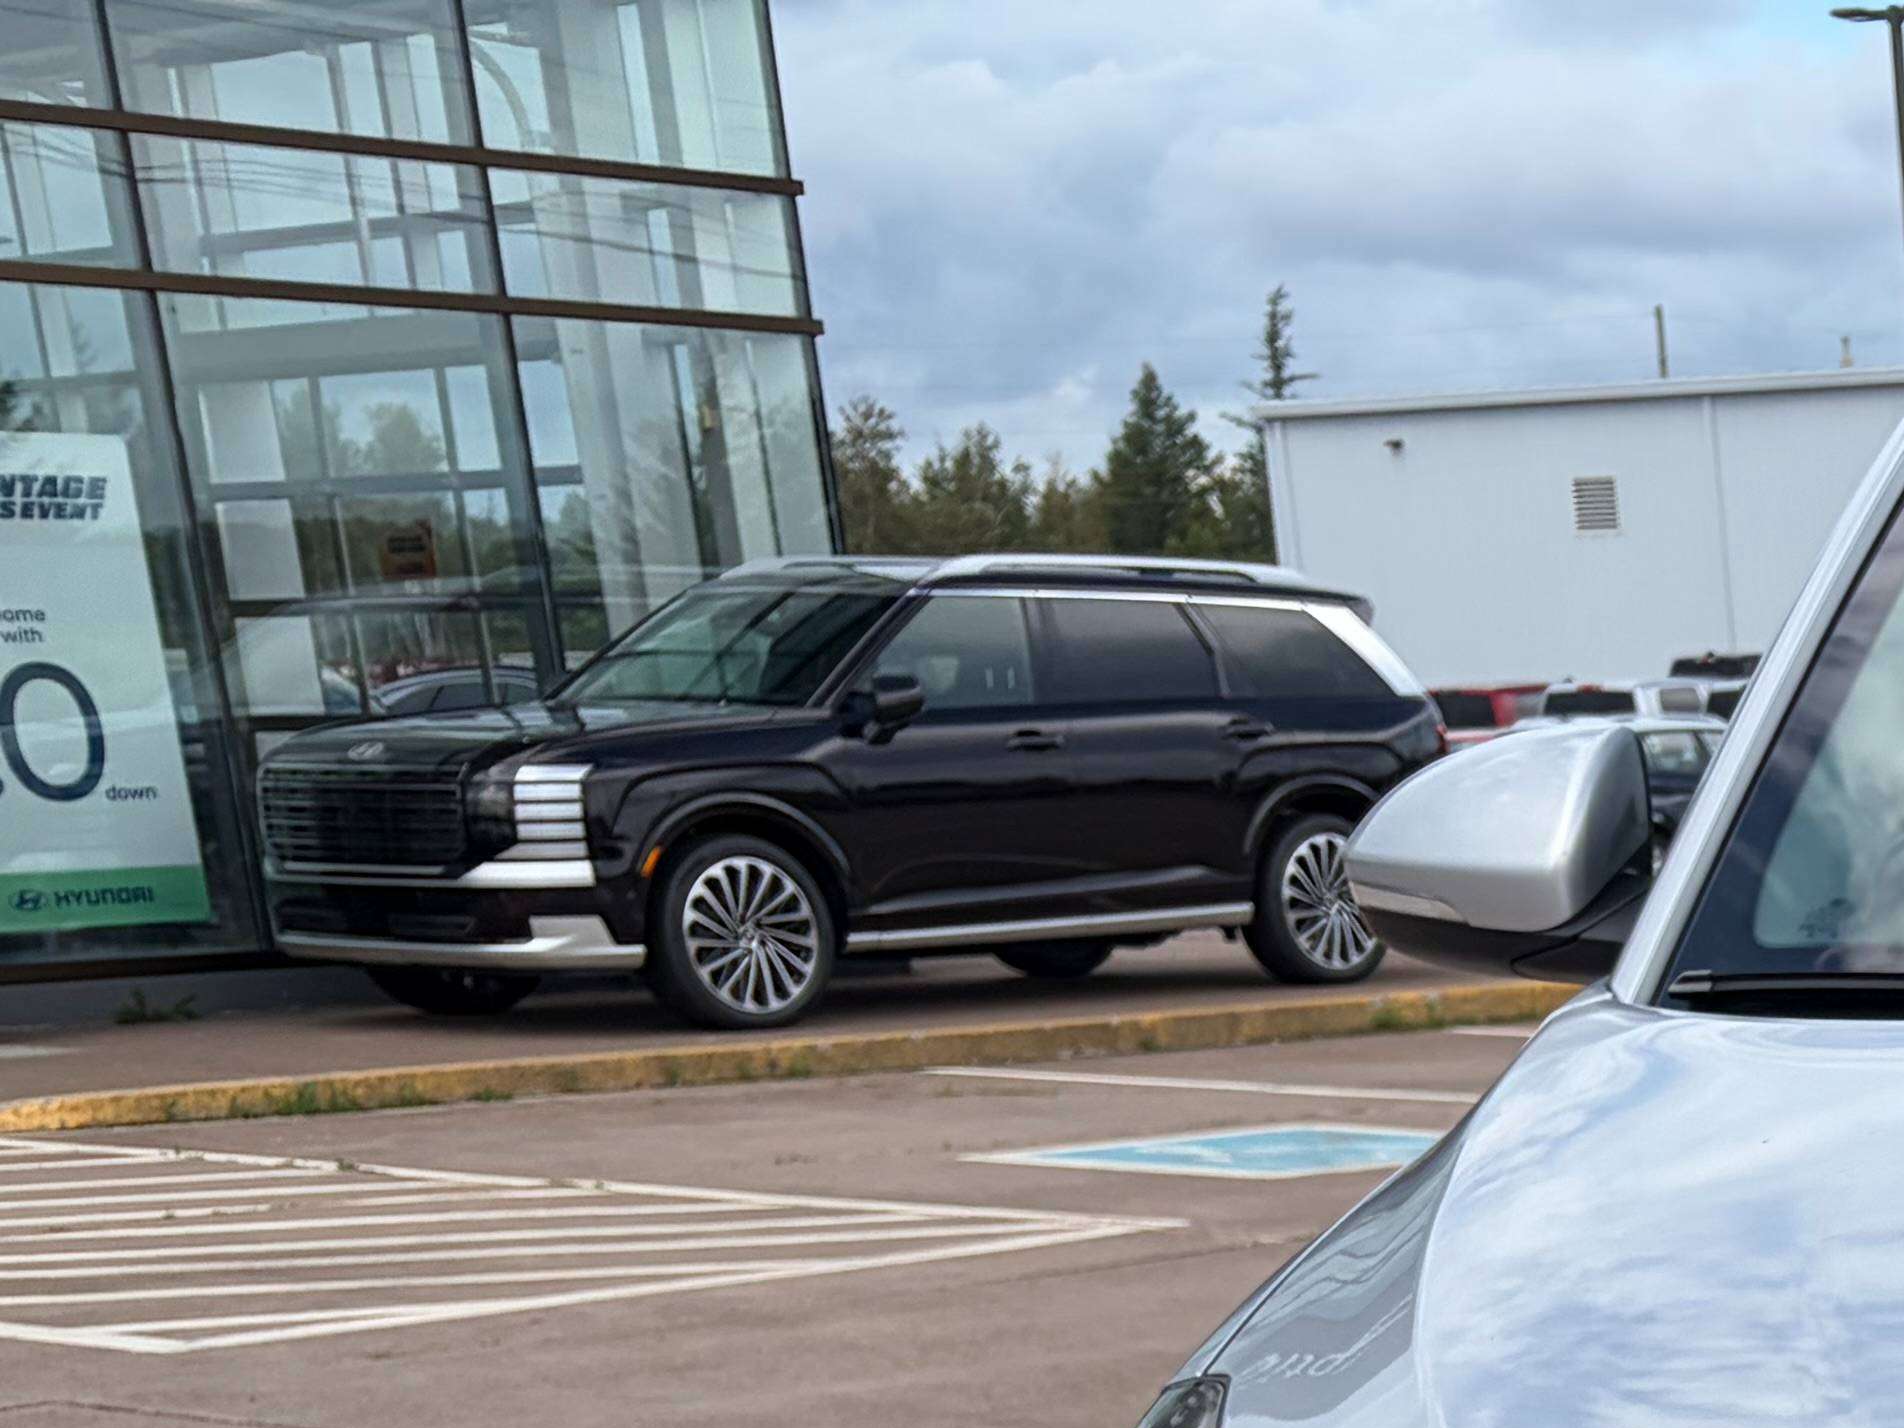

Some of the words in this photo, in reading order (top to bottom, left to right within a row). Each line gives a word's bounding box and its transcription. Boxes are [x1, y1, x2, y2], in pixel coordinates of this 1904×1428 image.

[0, 609, 45, 621] ome
[0, 626, 43, 643] with
[105, 784, 158, 800] down
[53, 885, 155, 906] HYUNDAI
